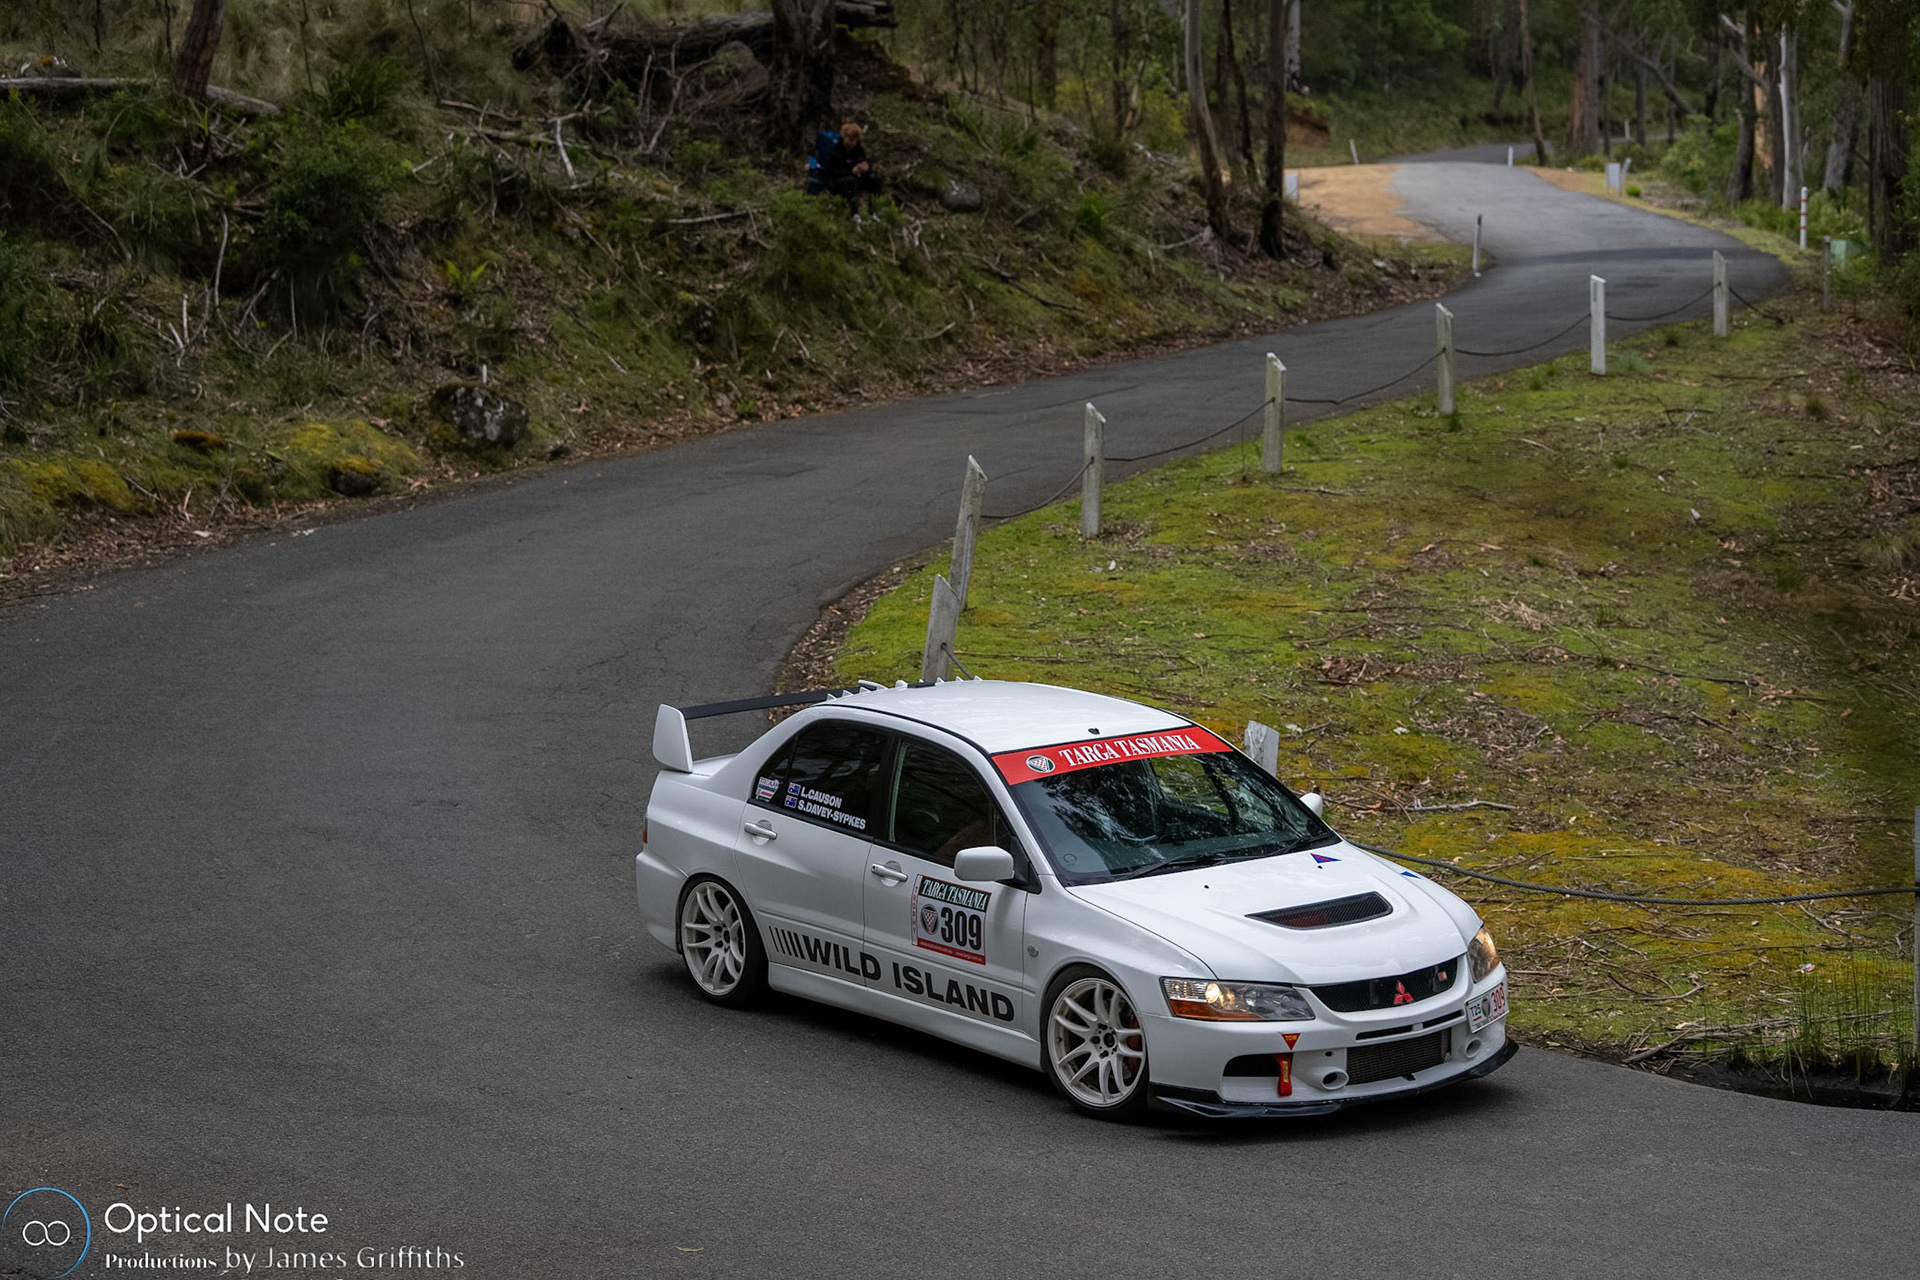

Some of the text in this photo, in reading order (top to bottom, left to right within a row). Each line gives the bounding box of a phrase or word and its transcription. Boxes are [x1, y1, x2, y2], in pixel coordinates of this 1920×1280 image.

[1059, 734, 1201, 766] TARGA TASMANIA
[801, 786, 843, 809] L.CAUSON
[797, 799, 867, 830] S.DAVEY-SYPKES
[922, 880, 988, 909] TARGA TASMANIA
[941, 907, 981, 950] 309
[801, 934, 1015, 1022] WILD ISLAND
[1491, 985, 1506, 1012] 309
